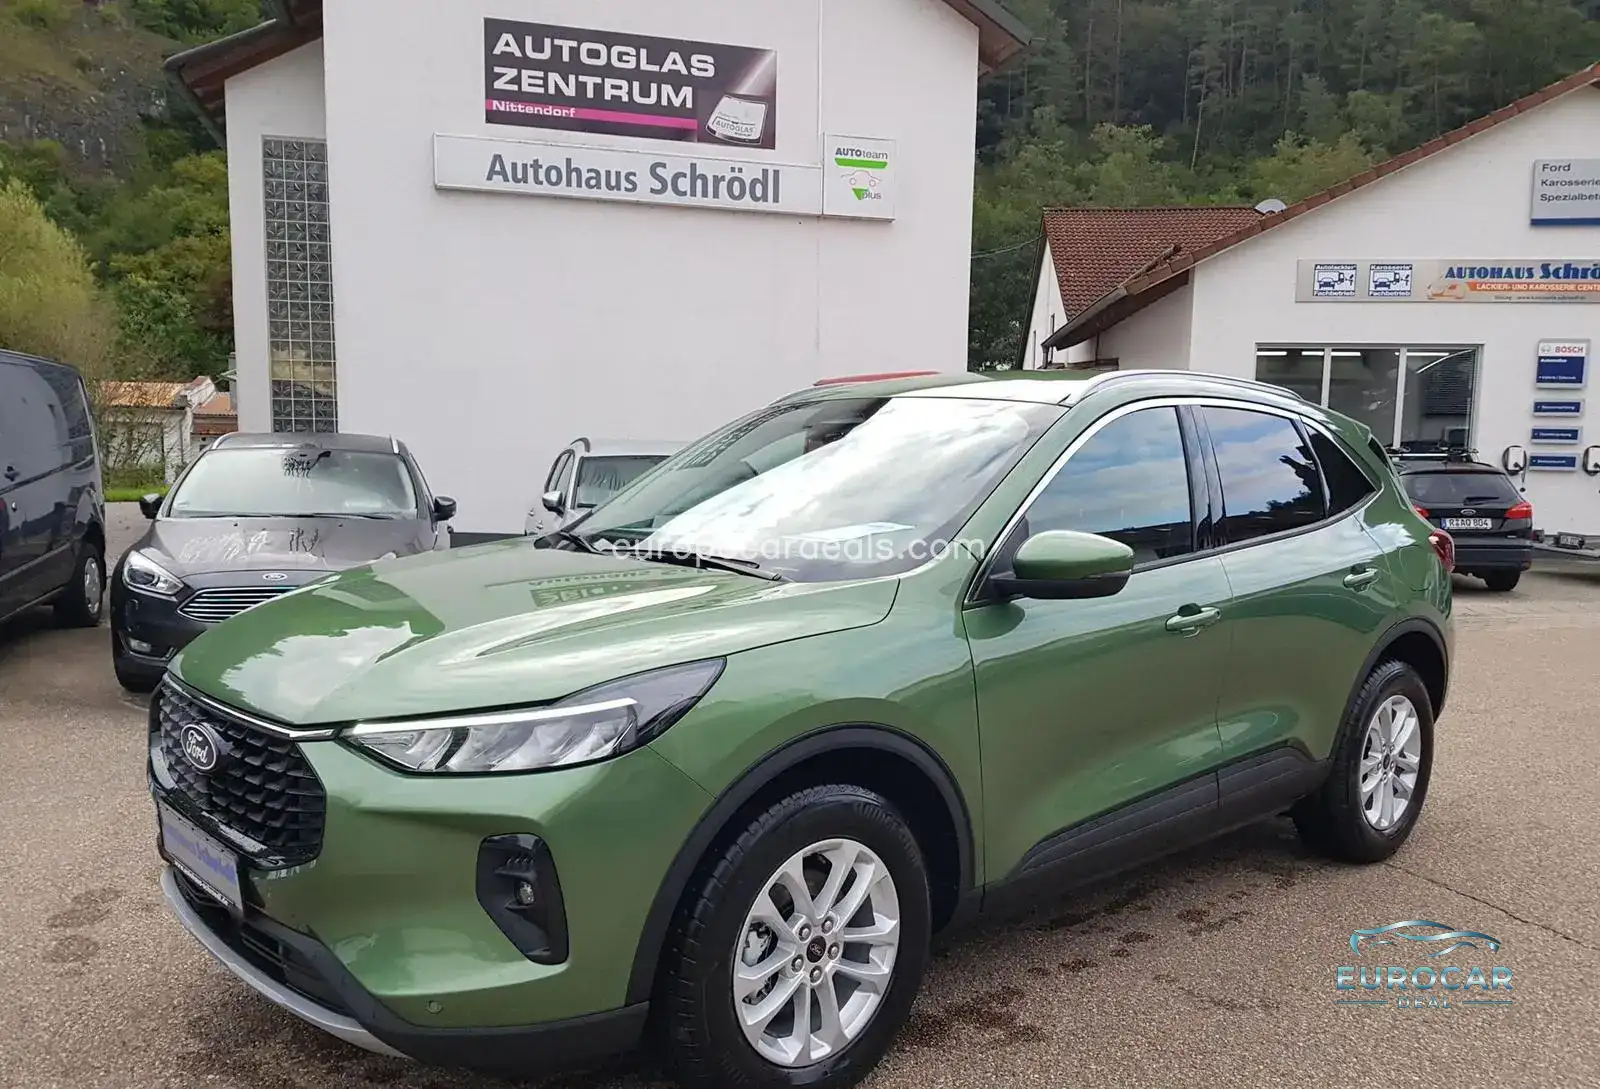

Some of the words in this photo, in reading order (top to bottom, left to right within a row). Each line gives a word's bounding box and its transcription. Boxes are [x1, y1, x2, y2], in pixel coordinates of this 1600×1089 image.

[492, 32, 716, 78] AUTOGLAS
[492, 66, 693, 109] ZENTRUM
[492, 99, 576, 118] Nittendorf
[1542, 163, 1571, 172] Ford
[486, 153, 638, 193] Autohaus
[649, 161, 780, 203] Schrödl
[1541, 179, 1600, 187] Karosserie
[861, 191, 882, 200] plus
[1540, 193, 1600, 203] Spezialbet
[1445, 266, 1534, 280] AUTOHAUS
[1476, 282, 1511, 291] LACKIER-
[1513, 283, 1528, 291] UND
[1529, 283, 1576, 292] KAROSSERIE
[186, 730, 209, 764] Ford
